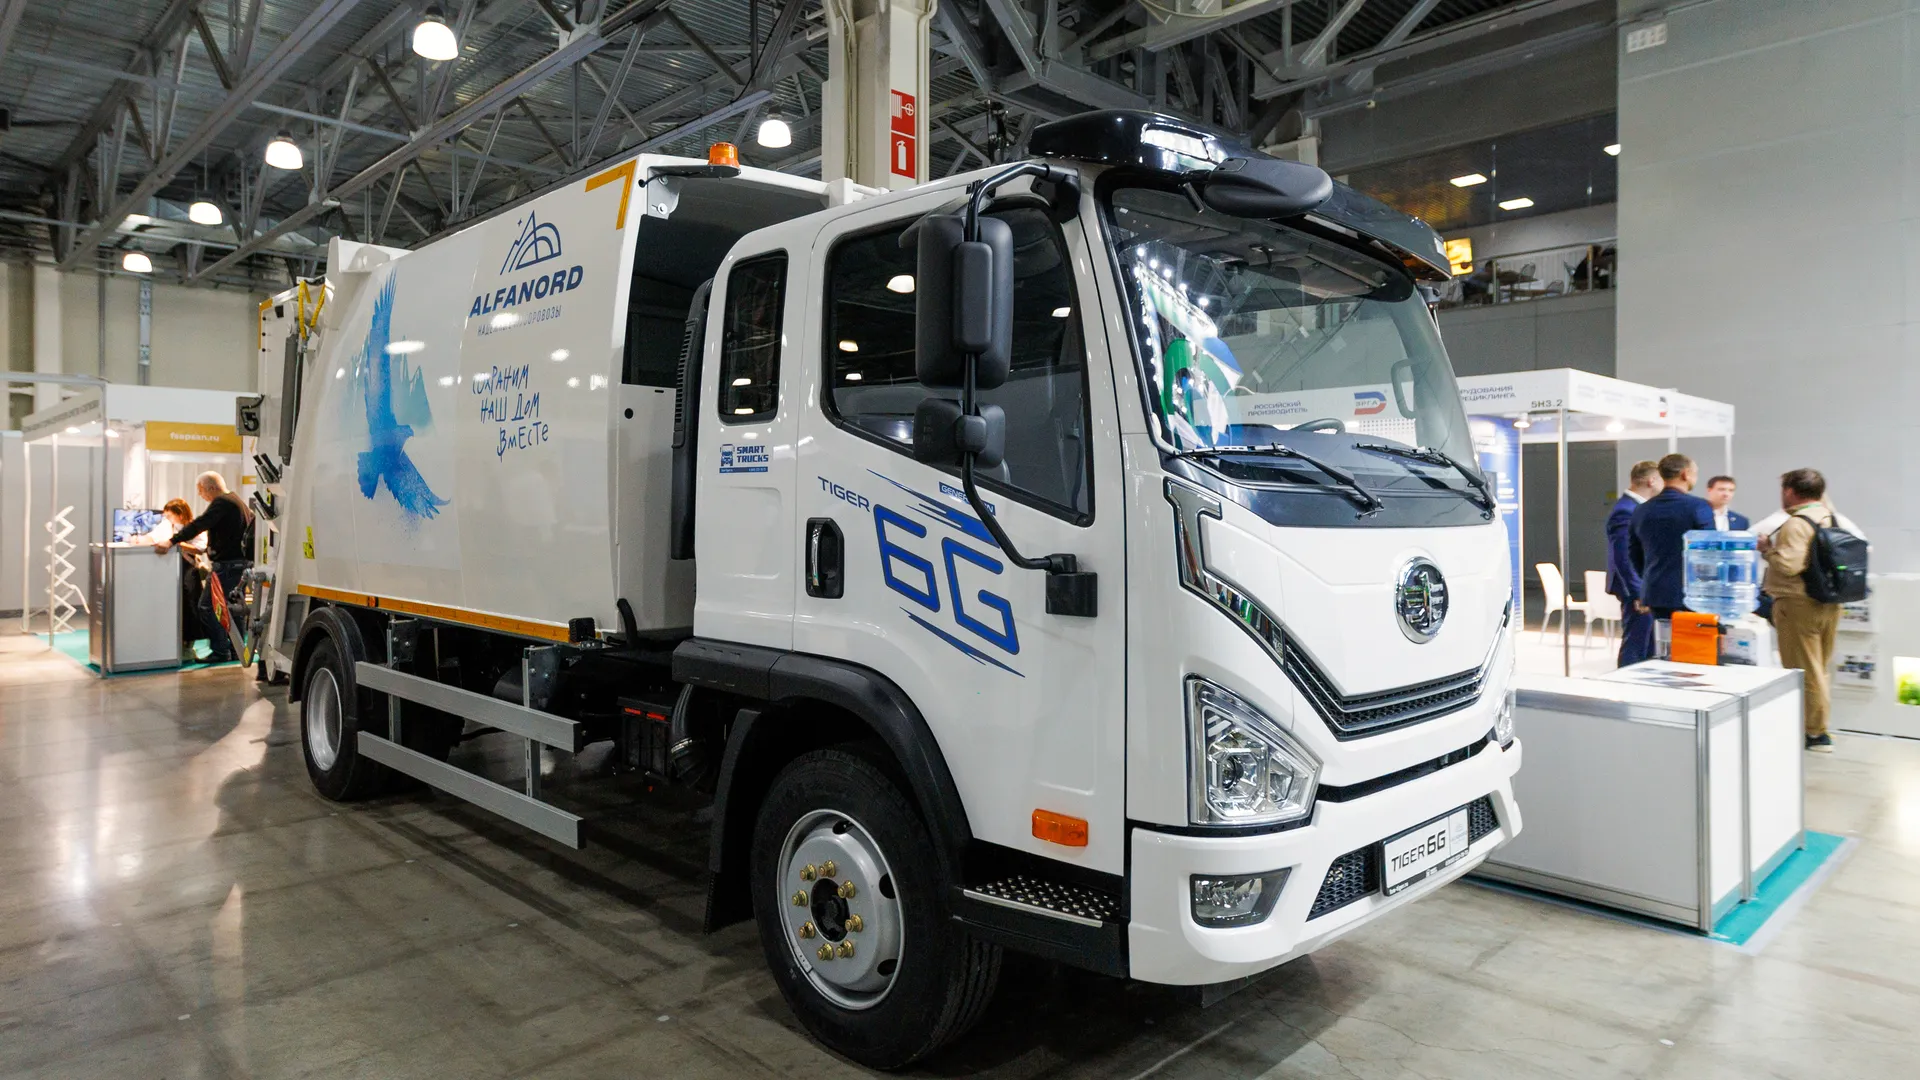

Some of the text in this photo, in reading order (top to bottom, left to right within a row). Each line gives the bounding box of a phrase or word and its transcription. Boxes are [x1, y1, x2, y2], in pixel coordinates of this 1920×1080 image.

[468, 265, 583, 318] ALFANORD
[1254, 400, 1301, 409] РОССИЙСКИЙ
[1531, 399, 1563, 408] 5H3.2
[481, 396, 507, 424] НАШ
[1248, 408, 1308, 416] ПРОИЗВОДИТЕЛЬ
[737, 445, 765, 454] SMART
[737, 455, 769, 463] TRUCKS
[818, 476, 1020, 655] TIGER 6G
[1391, 844, 1425, 872] TIGER
[1427, 830, 1446, 855] 6G
